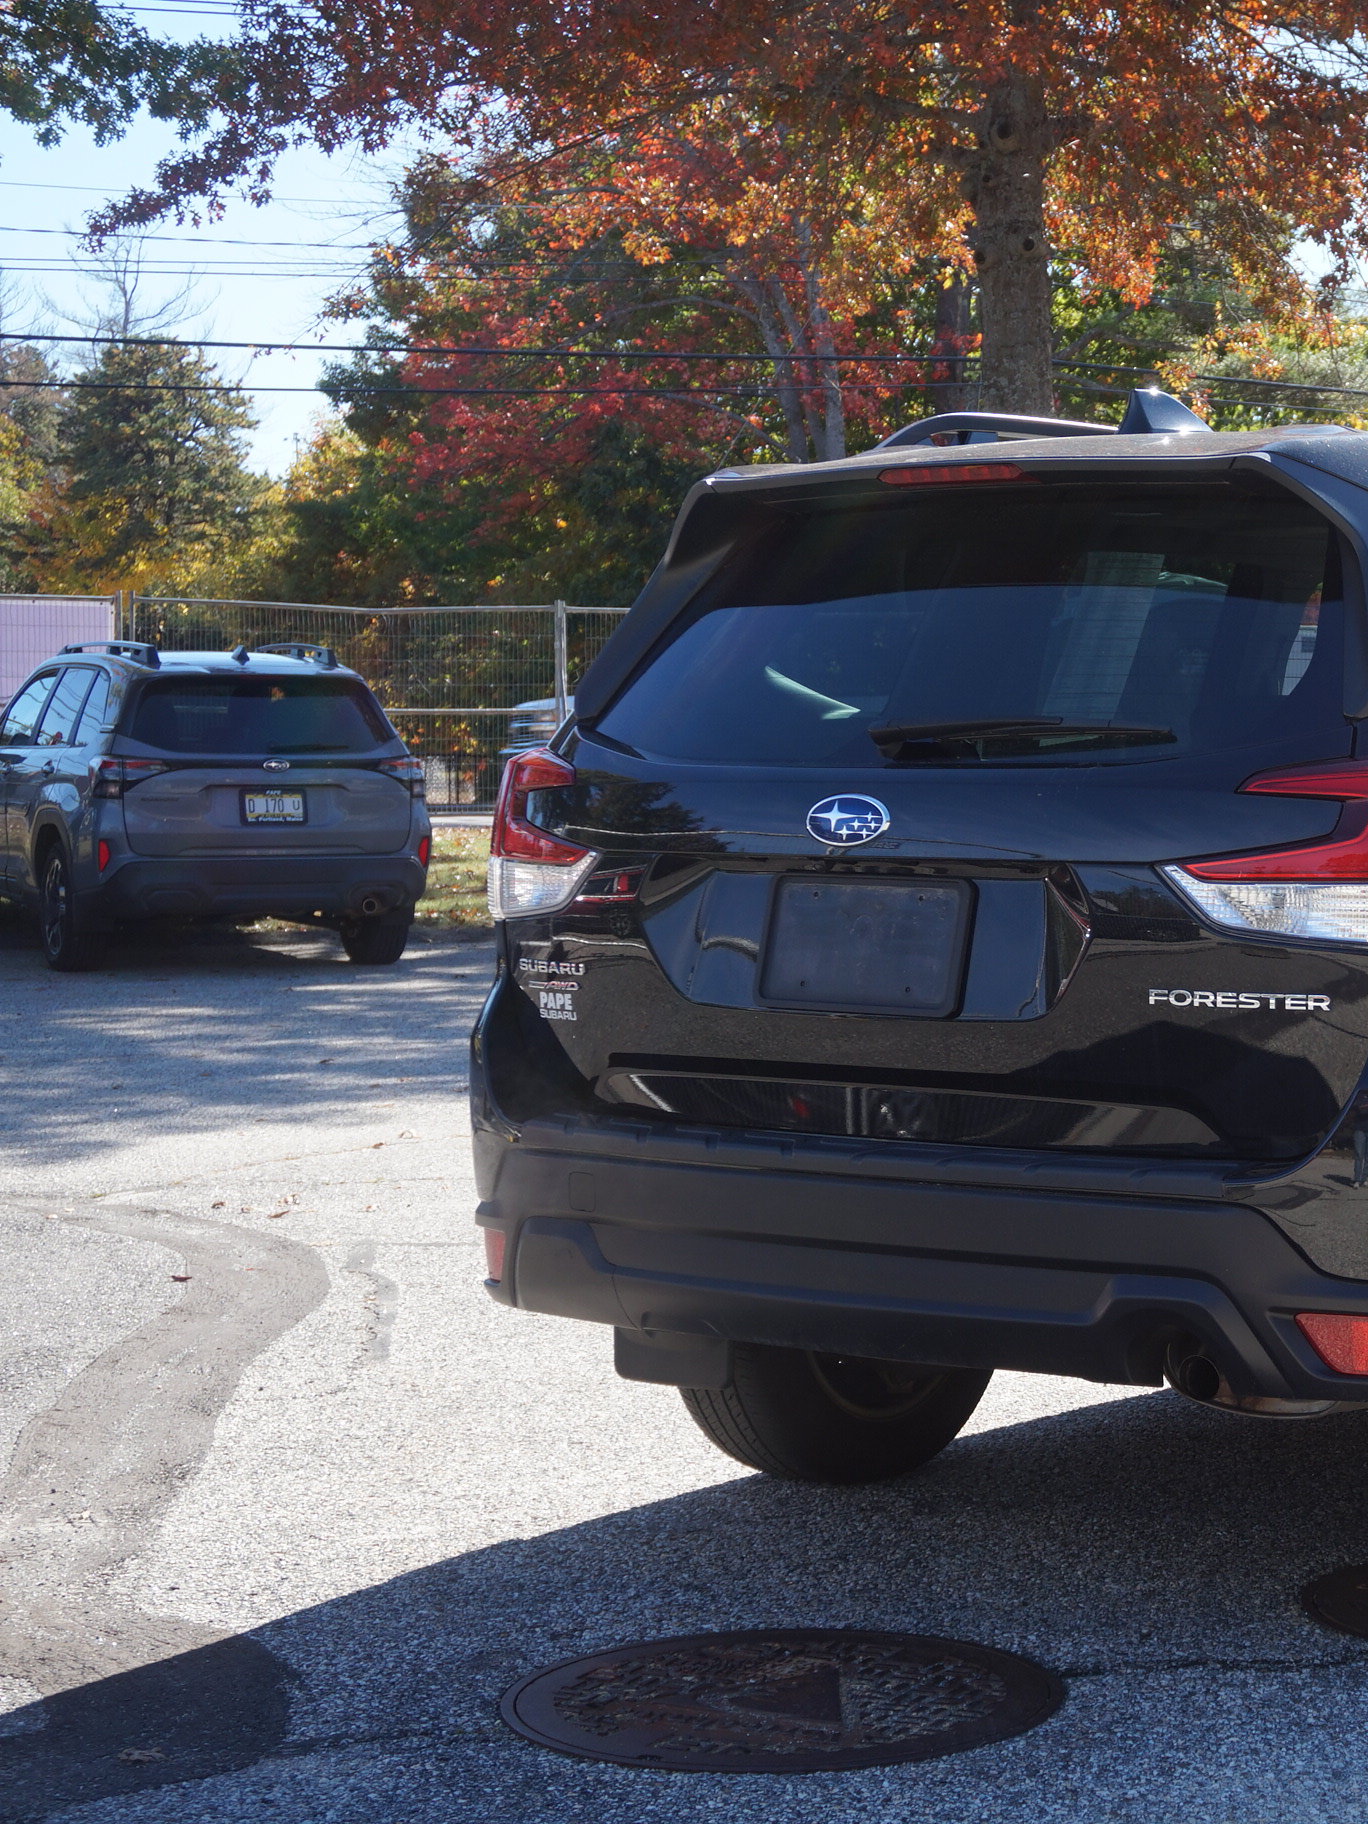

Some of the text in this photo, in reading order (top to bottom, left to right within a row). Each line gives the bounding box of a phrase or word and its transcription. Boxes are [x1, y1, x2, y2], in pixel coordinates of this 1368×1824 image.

[265, 799, 284, 813] 170
[292, 800, 300, 811] U
[519, 958, 585, 975] SUBARU
[545, 980, 580, 991] AWD
[540, 991, 573, 1010] PAPE
[1148, 988, 1331, 1012] FORESTER
[540, 1008, 578, 1021] SUBARU
